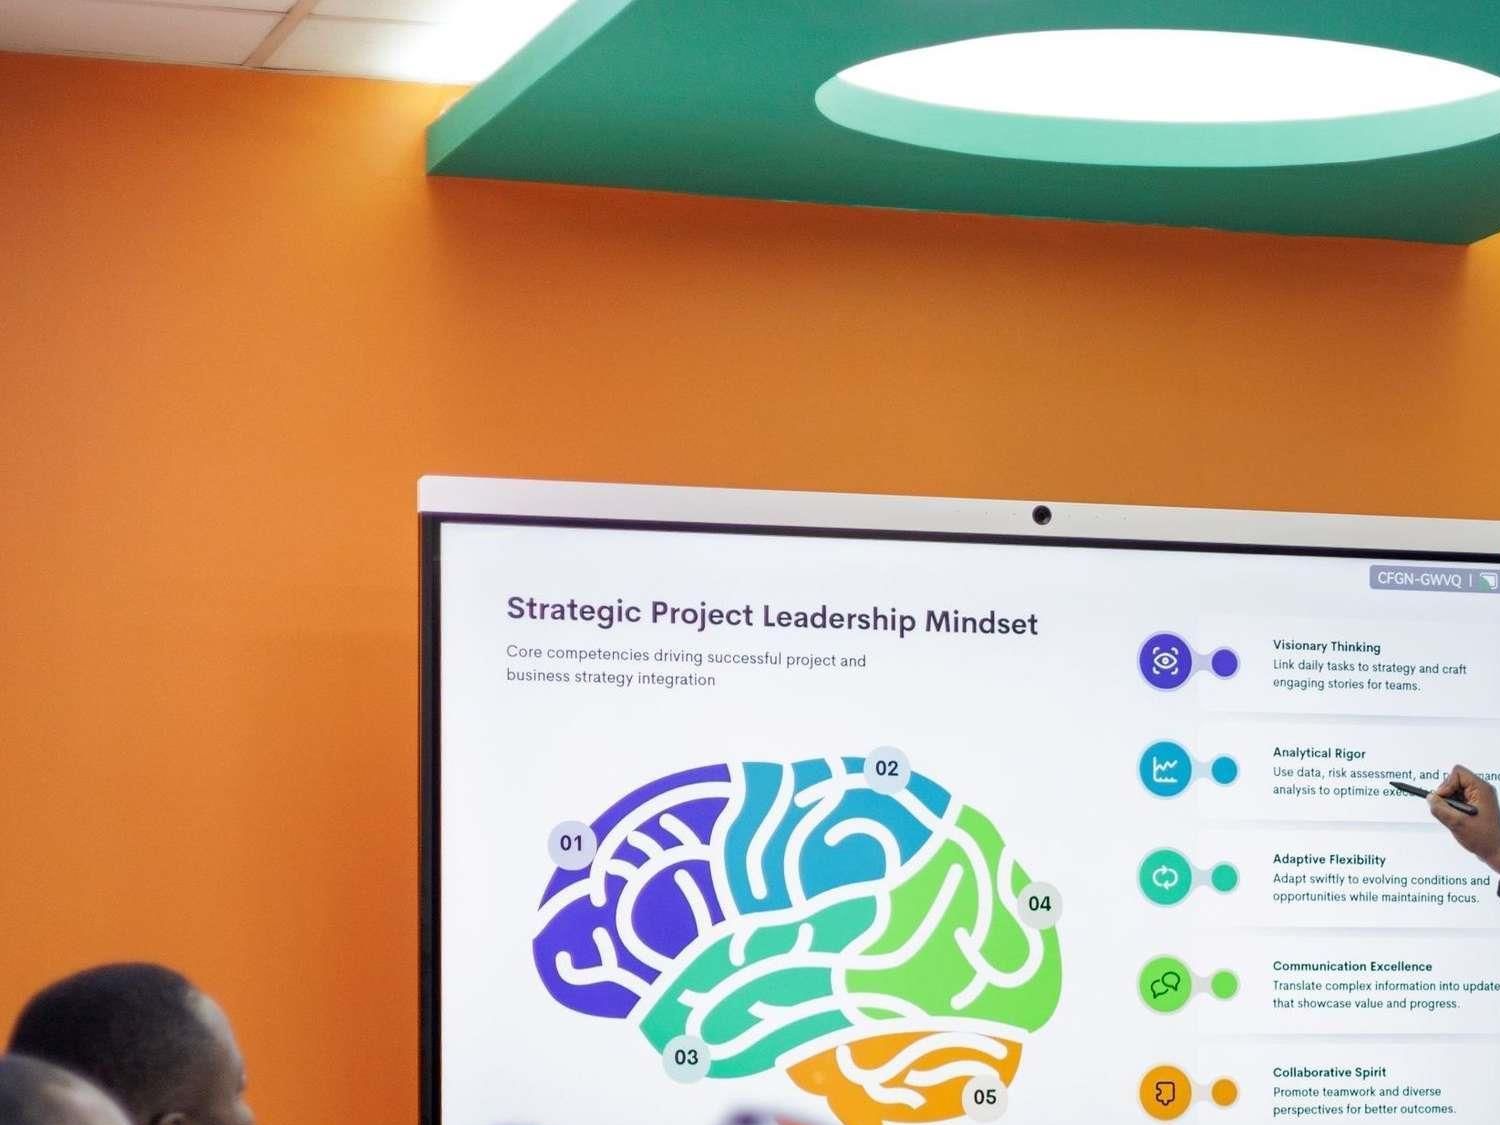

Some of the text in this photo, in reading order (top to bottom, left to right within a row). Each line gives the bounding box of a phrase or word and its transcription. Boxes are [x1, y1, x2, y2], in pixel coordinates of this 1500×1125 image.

[1378, 571, 1463, 589] CFGN-GWVQ
[507, 596, 1038, 639] Strategic Project Leadership Mindset
[1273, 639, 1380, 656] Visionary Thinking
[506, 644, 866, 669] Core competencies driving successful project and
[1273, 658, 1466, 676] Link daily tasks to strategy and craft
[506, 666, 715, 689] business strategy integration
[1273, 677, 1420, 691] engaging stories for teams.
[1273, 746, 1366, 761] Analytical Rigor
[876, 760, 899, 776] 02
[1273, 766, 1293, 777] Use
[1296, 766, 1324, 779] data,
[1328, 767, 1347, 778] risk
[1350, 769, 1416, 782] assessment,
[1419, 769, 1440, 781] and
[1273, 783, 1316, 797] analysis
[1319, 785, 1330, 795] to
[1333, 785, 1379, 798] optimize
[560, 835, 582, 851] 01
[1272, 853, 1386, 868] Adaptive Flexibility
[1273, 871, 1490, 888] Adapt swiftly to evolving conditions and
[1029, 896, 1051, 911] 04
[1272, 890, 1479, 906] opportunities while maintaining focus.
[1273, 960, 1432, 972] Communication Excellence
[1273, 979, 1322, 991] Translate
[1325, 979, 1371, 993] complex
[1375, 979, 1435, 991] information
[1439, 980, 1460, 991] into
[1272, 997, 1460, 1011] that showcase value and progress.
[675, 1049, 698, 1065] 03
[1272, 1066, 1386, 1080] Collaborative Spirit
[974, 1089, 997, 1105] 05
[1273, 1085, 1441, 1097] Promote teamwork and diverse
[1272, 1103, 1456, 1117] perspectives for better outcomes.
